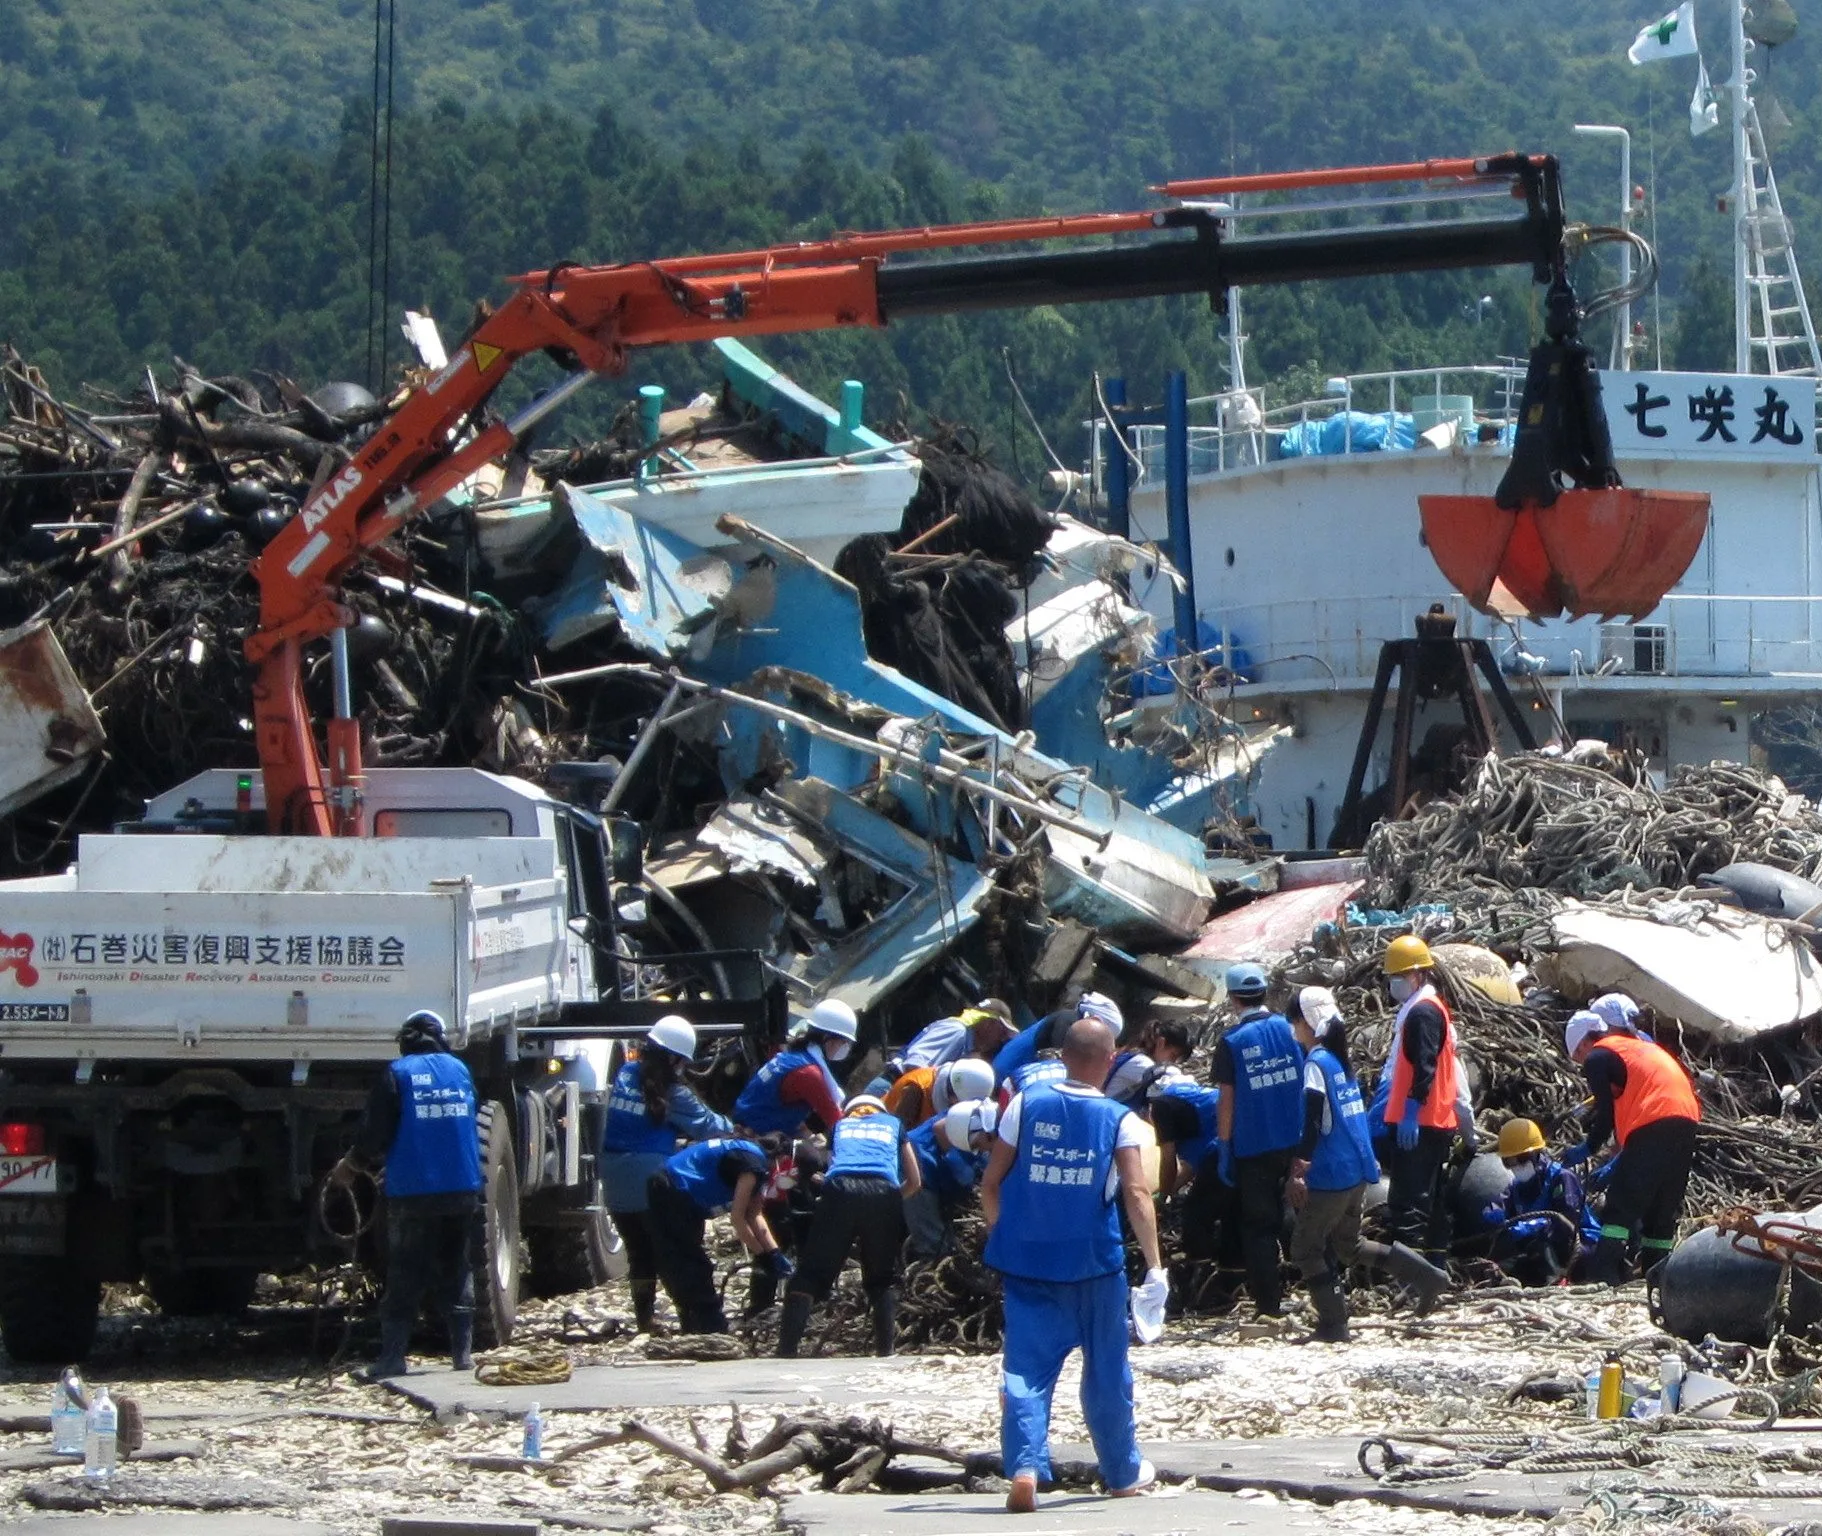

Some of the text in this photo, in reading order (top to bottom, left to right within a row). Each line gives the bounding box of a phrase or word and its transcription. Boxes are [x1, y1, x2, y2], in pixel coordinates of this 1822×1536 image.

[1624, 382, 1804, 445] 七咲丸
[302, 466, 362, 532] ATLAS
[57, 971, 125, 982] Ishinomaki
[129, 971, 181, 982] Disaster
[185, 972, 243, 984] Recovery
[248, 972, 316, 983] Assistance
